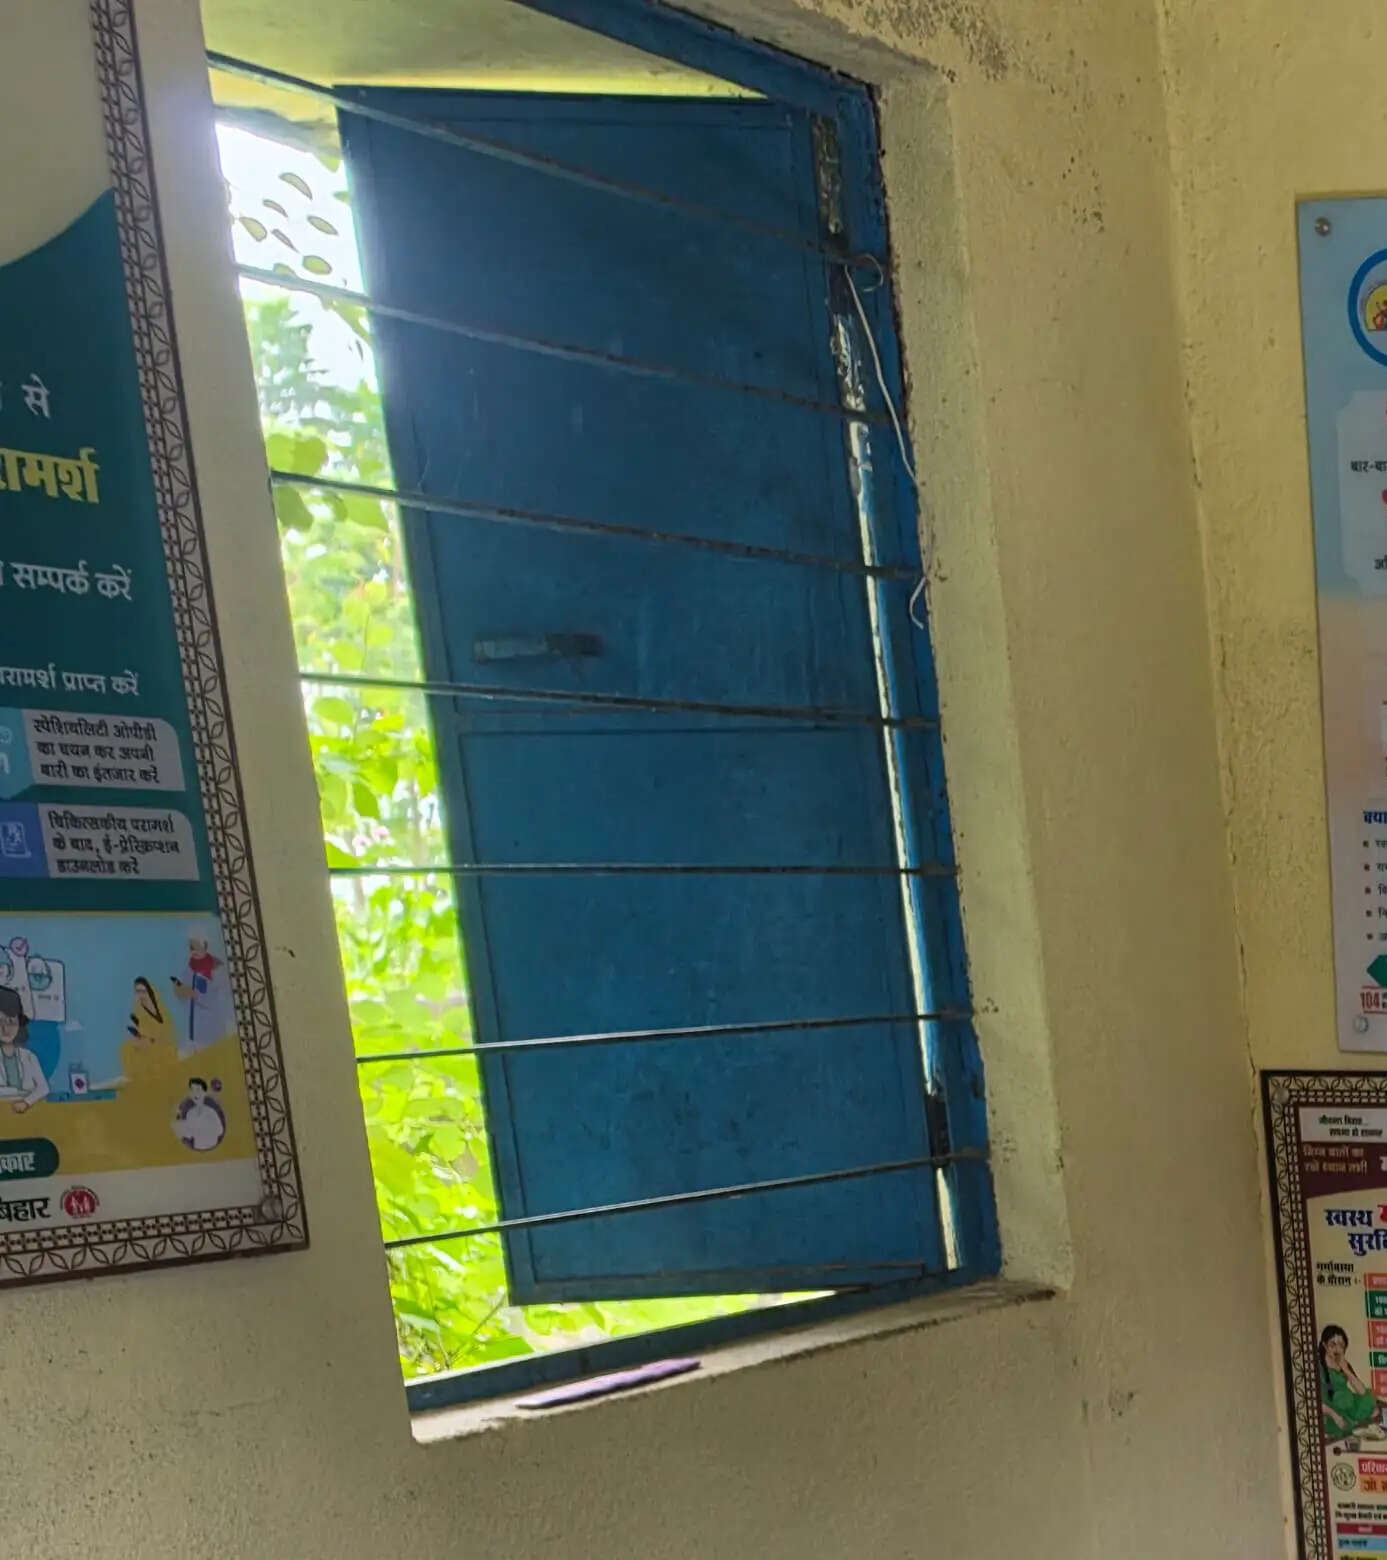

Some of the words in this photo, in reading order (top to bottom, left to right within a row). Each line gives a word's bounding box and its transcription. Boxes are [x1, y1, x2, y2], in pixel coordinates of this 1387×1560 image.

[22, 373, 50, 418] से
[10, 560, 89, 595] सम्पर्क
[96, 563, 132, 601] करें
[62, 670, 105, 695] प्राप्त
[111, 669, 139, 697] करें
[1325, 1209, 1373, 1227] स्वस्थ
